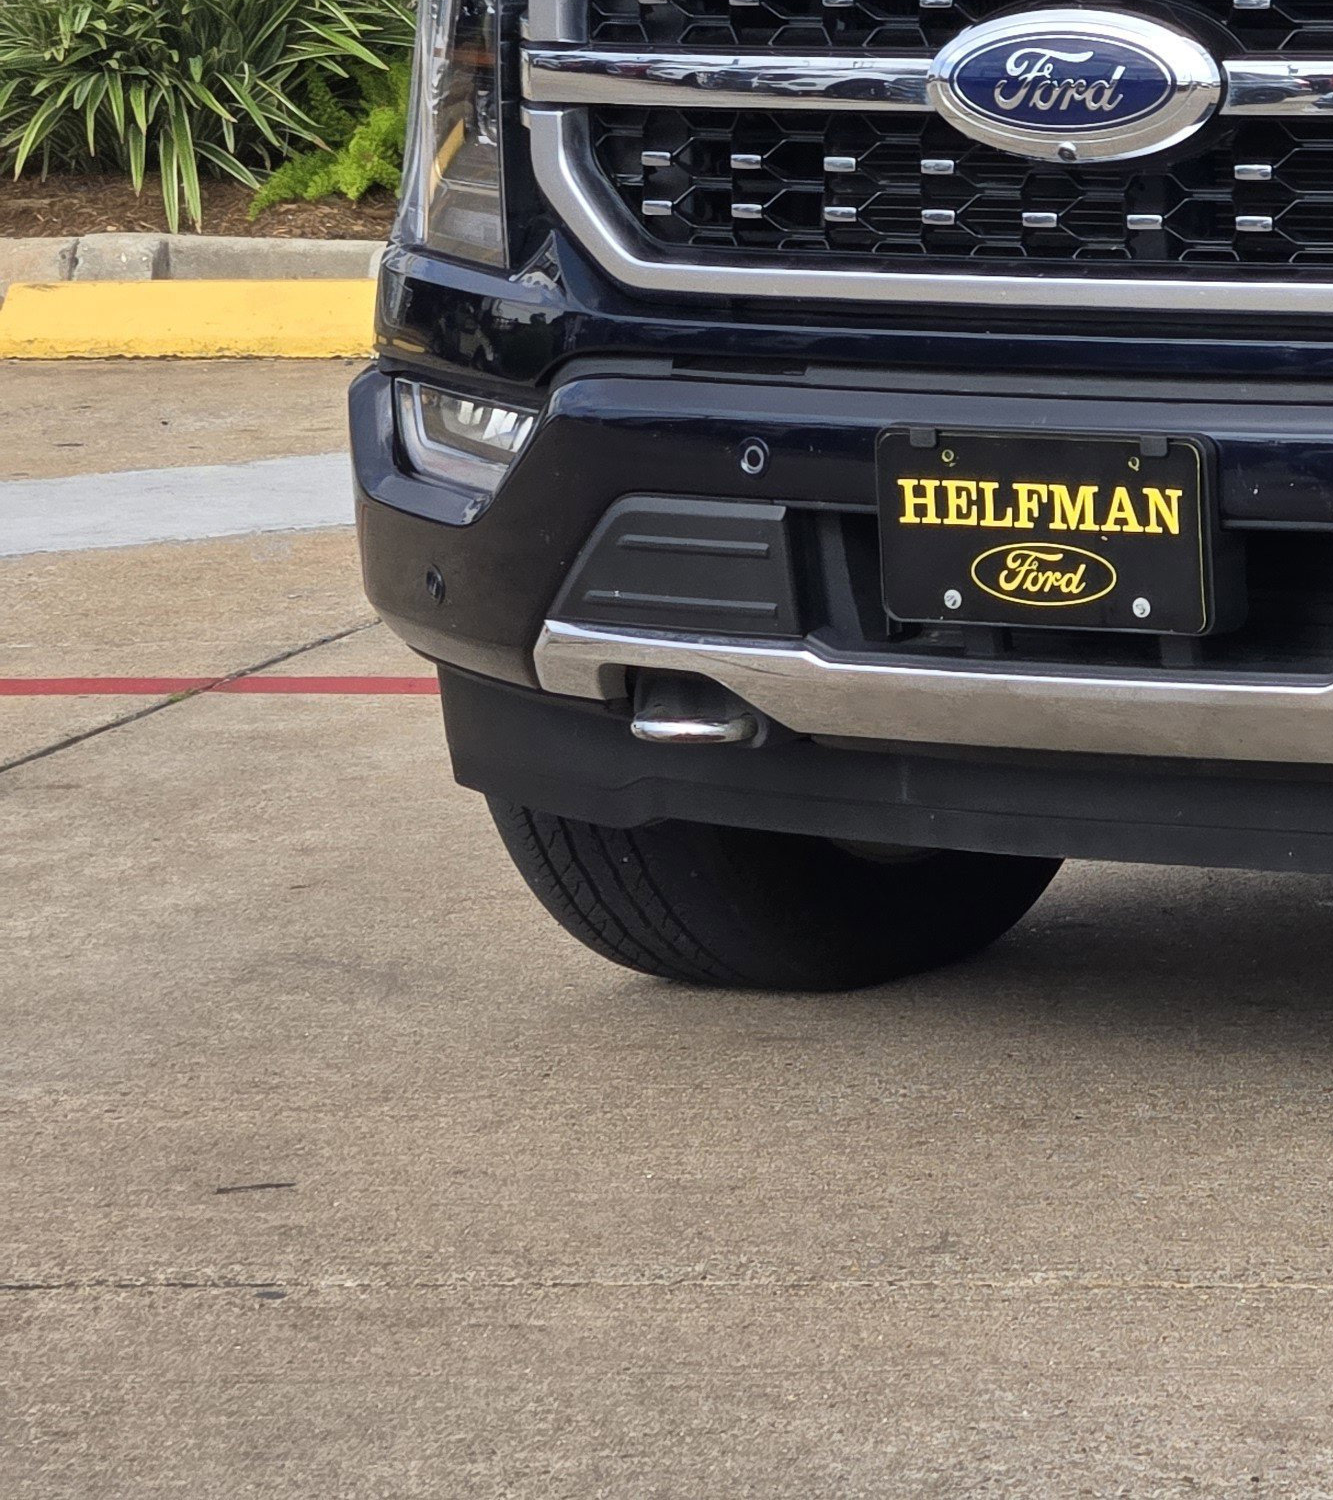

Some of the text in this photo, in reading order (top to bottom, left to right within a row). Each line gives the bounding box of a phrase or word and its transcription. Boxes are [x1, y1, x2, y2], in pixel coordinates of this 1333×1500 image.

[994, 46, 1126, 112] Ford
[897, 477, 1182, 535] HELFMAN
[998, 549, 1087, 595] Ford
